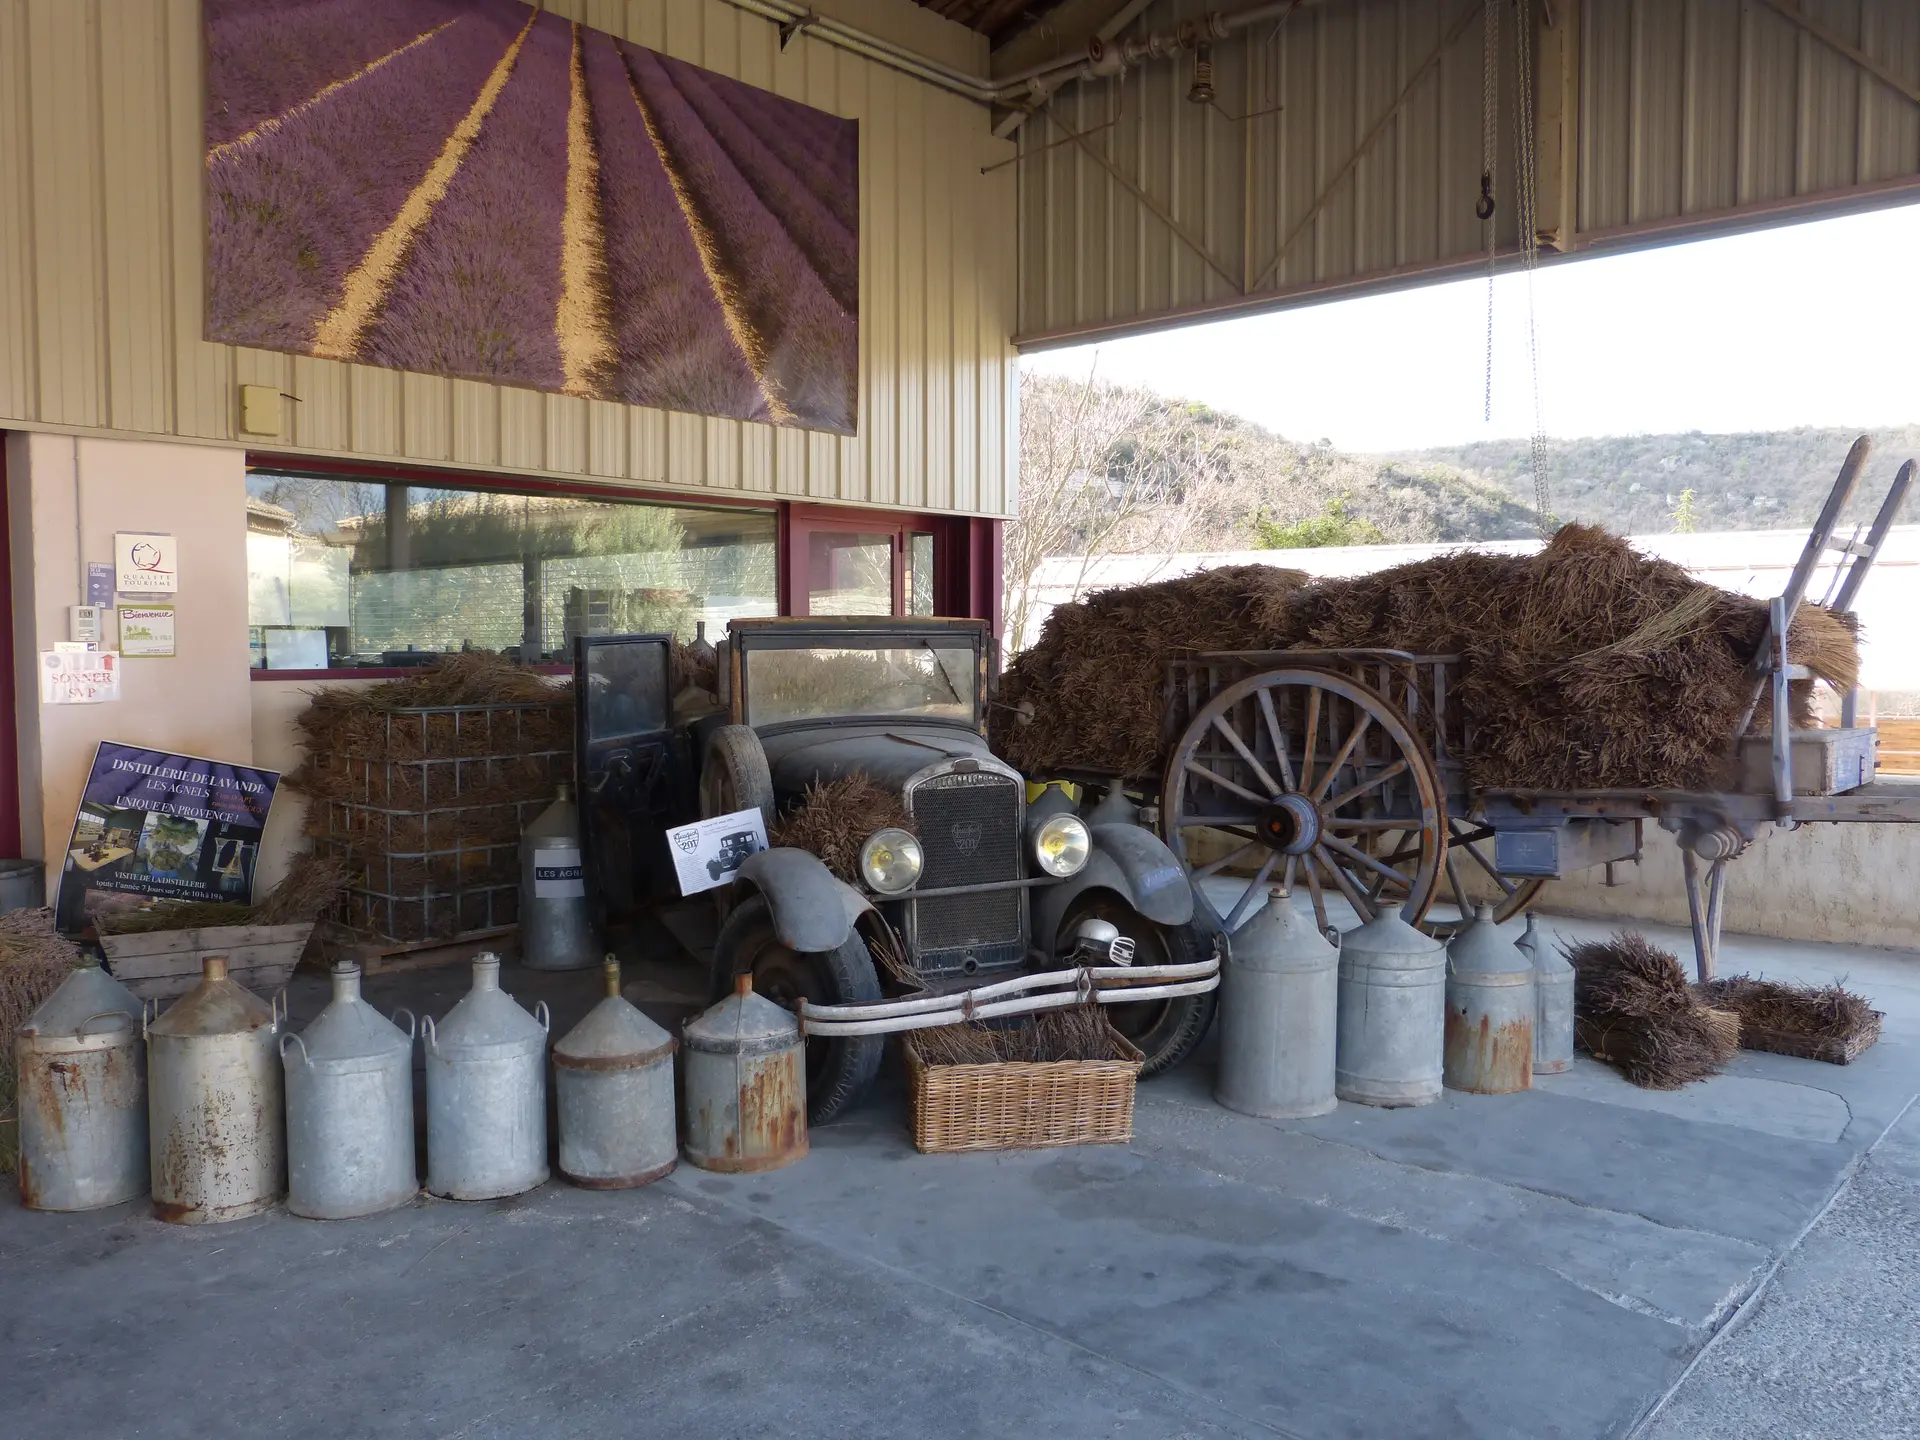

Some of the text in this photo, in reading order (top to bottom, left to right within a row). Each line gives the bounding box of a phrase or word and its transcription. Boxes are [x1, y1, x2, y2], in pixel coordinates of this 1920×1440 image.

[119, 609, 173, 619] Bienvenue
[52, 673, 112, 683] SONNER
[68, 688, 96, 698] SVP
[112, 759, 266, 794] DISTILLERIE DE LAVANDE
[146, 779, 211, 798] LES AGNELS
[116, 795, 161, 811] UNIQUE
[161, 802, 178, 813] EN
[177, 805, 234, 823] PROVENCE
[681, 839, 697, 850] 201
[538, 870, 556, 878] LES
[96, 880, 114, 888] toute
[114, 871, 208, 889] VISITE DE LA DISTILLERIE
